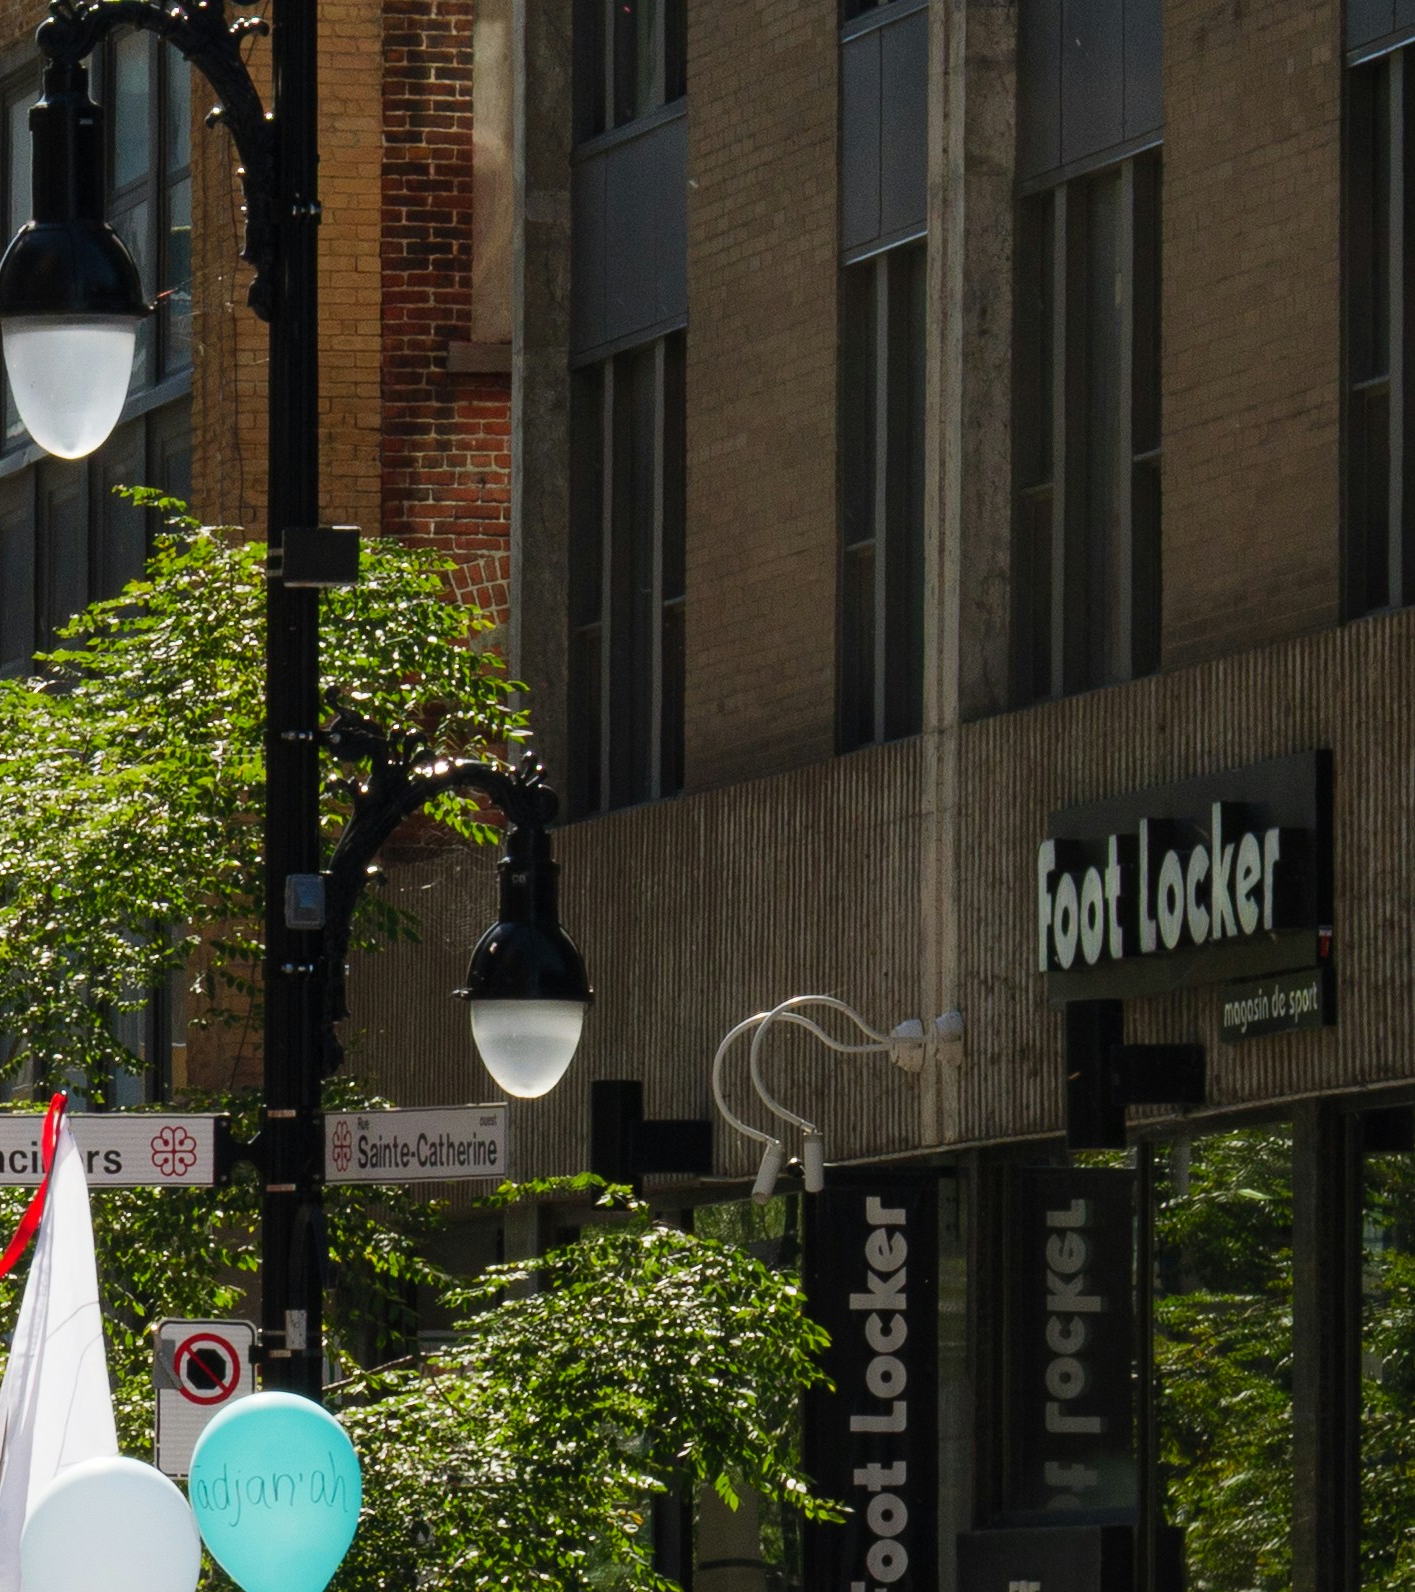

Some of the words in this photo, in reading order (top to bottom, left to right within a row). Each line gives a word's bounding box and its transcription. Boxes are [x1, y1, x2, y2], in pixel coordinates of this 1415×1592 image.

[1038, 834, 1123, 972] Foot
[1139, 802, 1280, 954] Locker
[1224, 988, 1269, 1033] magasin
[1272, 984, 1287, 1017] de
[1289, 982, 1318, 1023] sport
[358, 1132, 497, 1169] Sainte-Catherine
[850, 1196, 909, 1433] Locker
